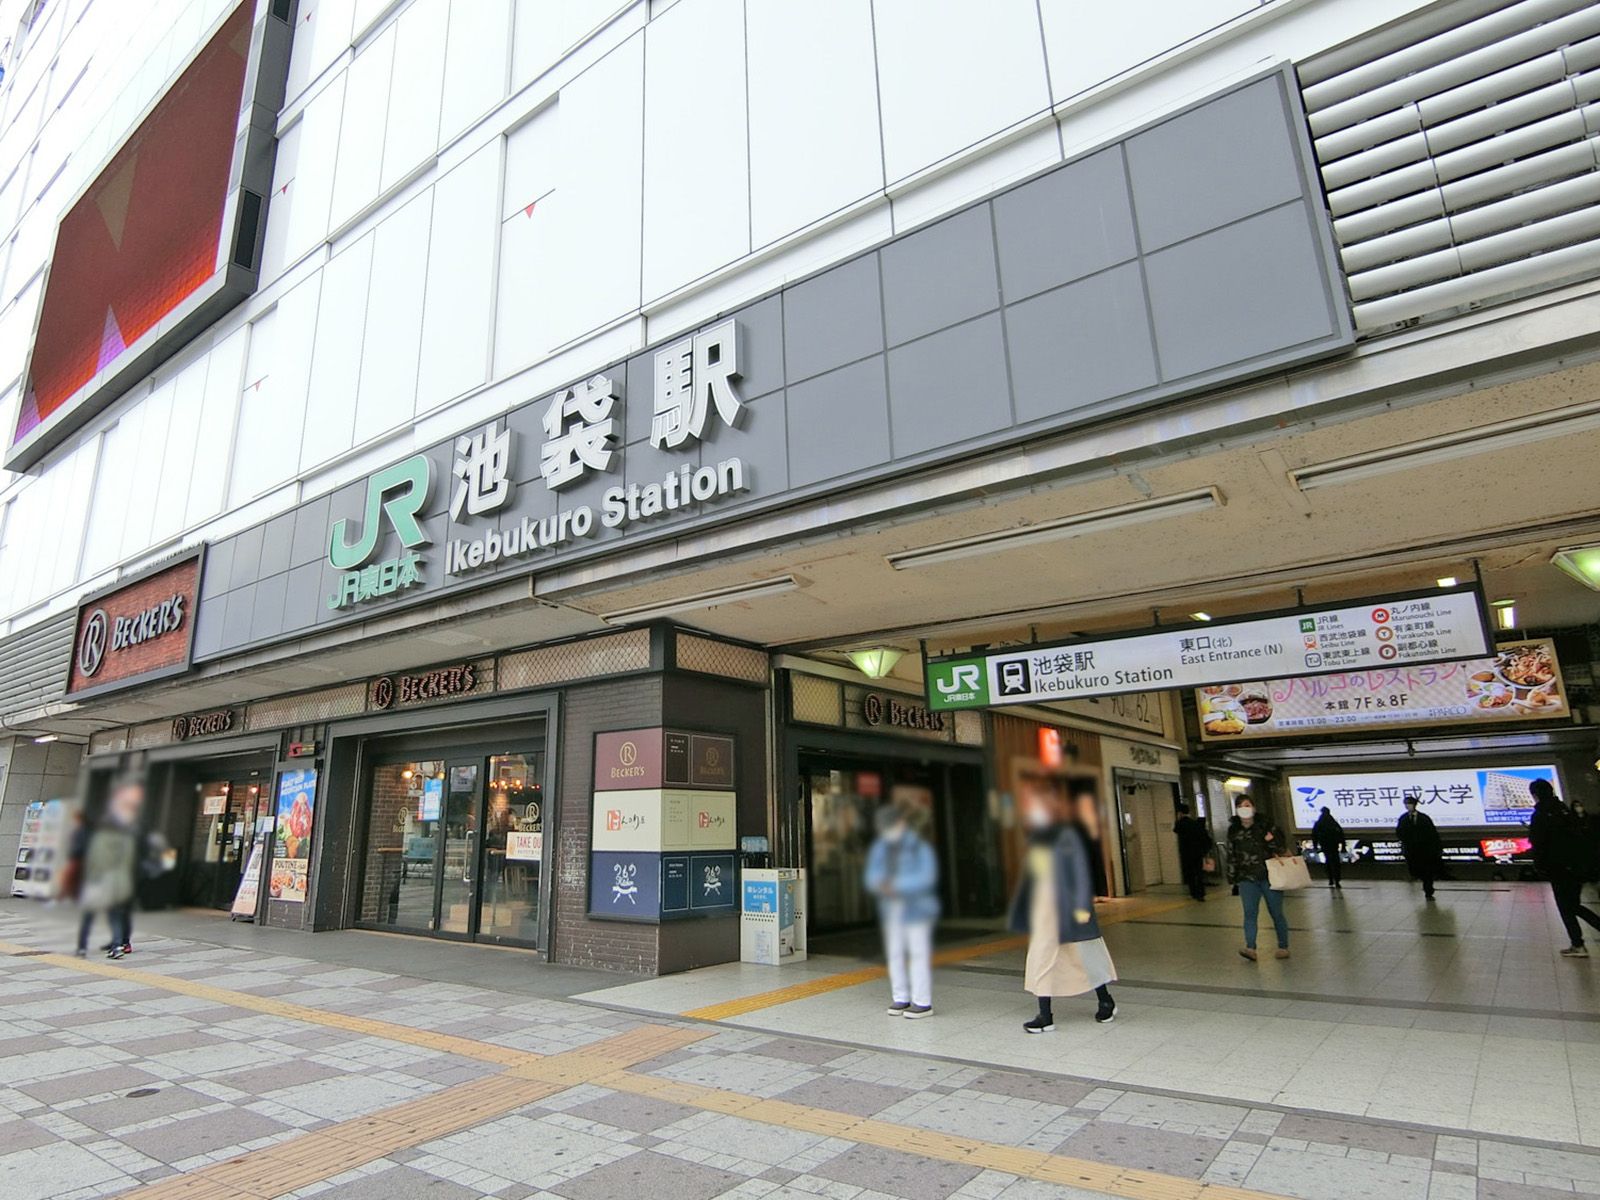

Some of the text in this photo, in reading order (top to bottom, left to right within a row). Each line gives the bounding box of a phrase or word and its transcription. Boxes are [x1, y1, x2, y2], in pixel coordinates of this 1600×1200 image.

[448, 319, 746, 524] 池袋駅
[328, 454, 436, 569] JR
[445, 457, 750, 575] Ikebukuro Station
[327, 551, 425, 610] JR東日本
[1390, 602, 1431, 615] 丸ノ内線
[1391, 609, 1452, 622] Marunouchi Line
[111, 594, 184, 651] BECKER'S
[1316, 615, 1338, 625] JR線
[1326, 623, 1344, 631] Lines
[1394, 621, 1435, 633] 有楽町線
[1319, 629, 1367, 642] 西武池袋線
[1395, 628, 1452, 640] Yurakucho Line
[1179, 636, 1233, 653] 東口(北)
[1320, 641, 1340, 650] Seibu
[1181, 643, 1283, 665] East Entrance (N)
[1322, 647, 1371, 660] 東武東上線
[1398, 647, 1457, 659] Fukutoshin Line
[1033, 651, 1095, 676] 池袋駅
[1324, 657, 1357, 667] Tobu Line
[400, 664, 475, 702] BECKER'S
[937, 664, 981, 694] JR
[1034, 667, 1173, 694] Ikebukuro Station
[1354, 696, 1373, 710] 7F
[1376, 698, 1387, 708] &
[1389, 694, 1409, 707] 8F
[189, 710, 233, 736] BECKER'S
[890, 700, 944, 731] BECKERS
[610, 765, 645, 779] BECKER'S
[1333, 783, 1474, 808] 帝京平成大学
[519, 823, 542, 832] BECKER
[516, 836, 542, 849] TAKE OU
